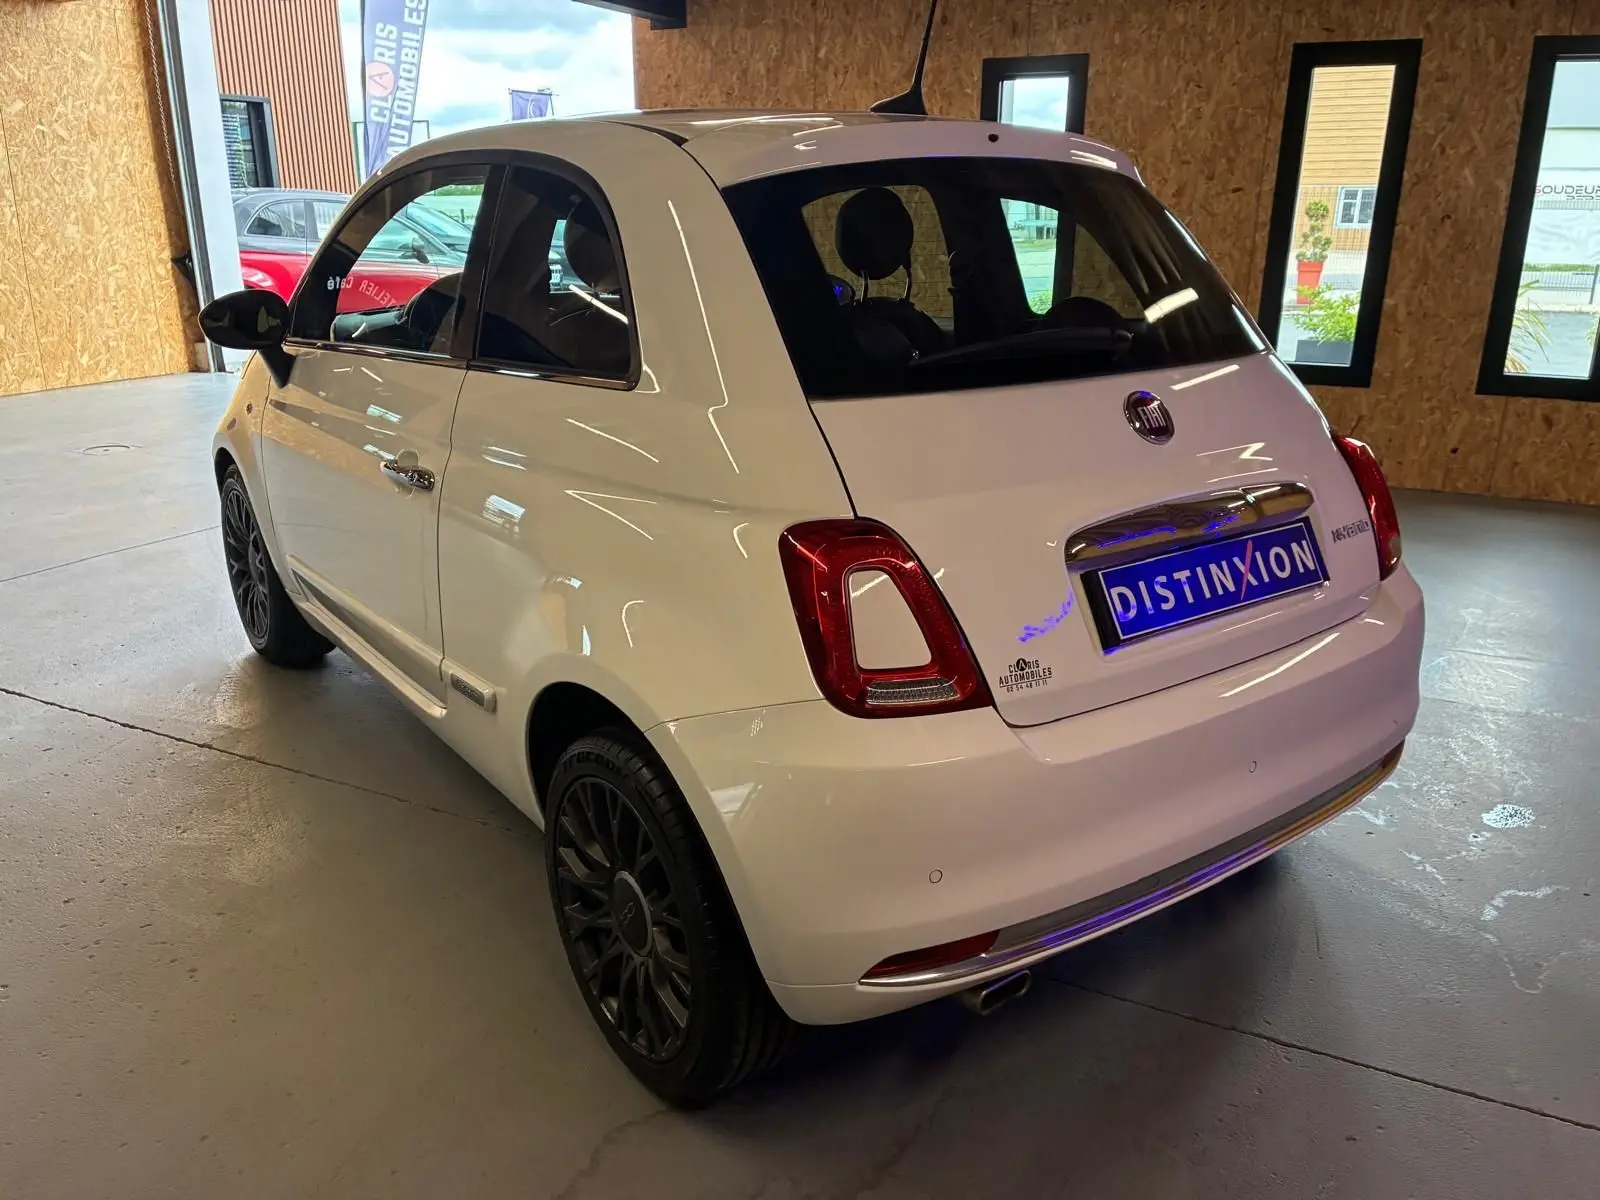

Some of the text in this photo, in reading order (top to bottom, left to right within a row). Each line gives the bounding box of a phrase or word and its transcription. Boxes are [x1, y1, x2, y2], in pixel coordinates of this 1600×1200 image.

[366, 22, 398, 124] CLARIS
[1137, 402, 1167, 429] FIAT
[1109, 539, 1316, 622] DISTINXION
[999, 667, 1052, 685] AUTOMOBILES
[1008, 658, 1040, 673] CLARIS
